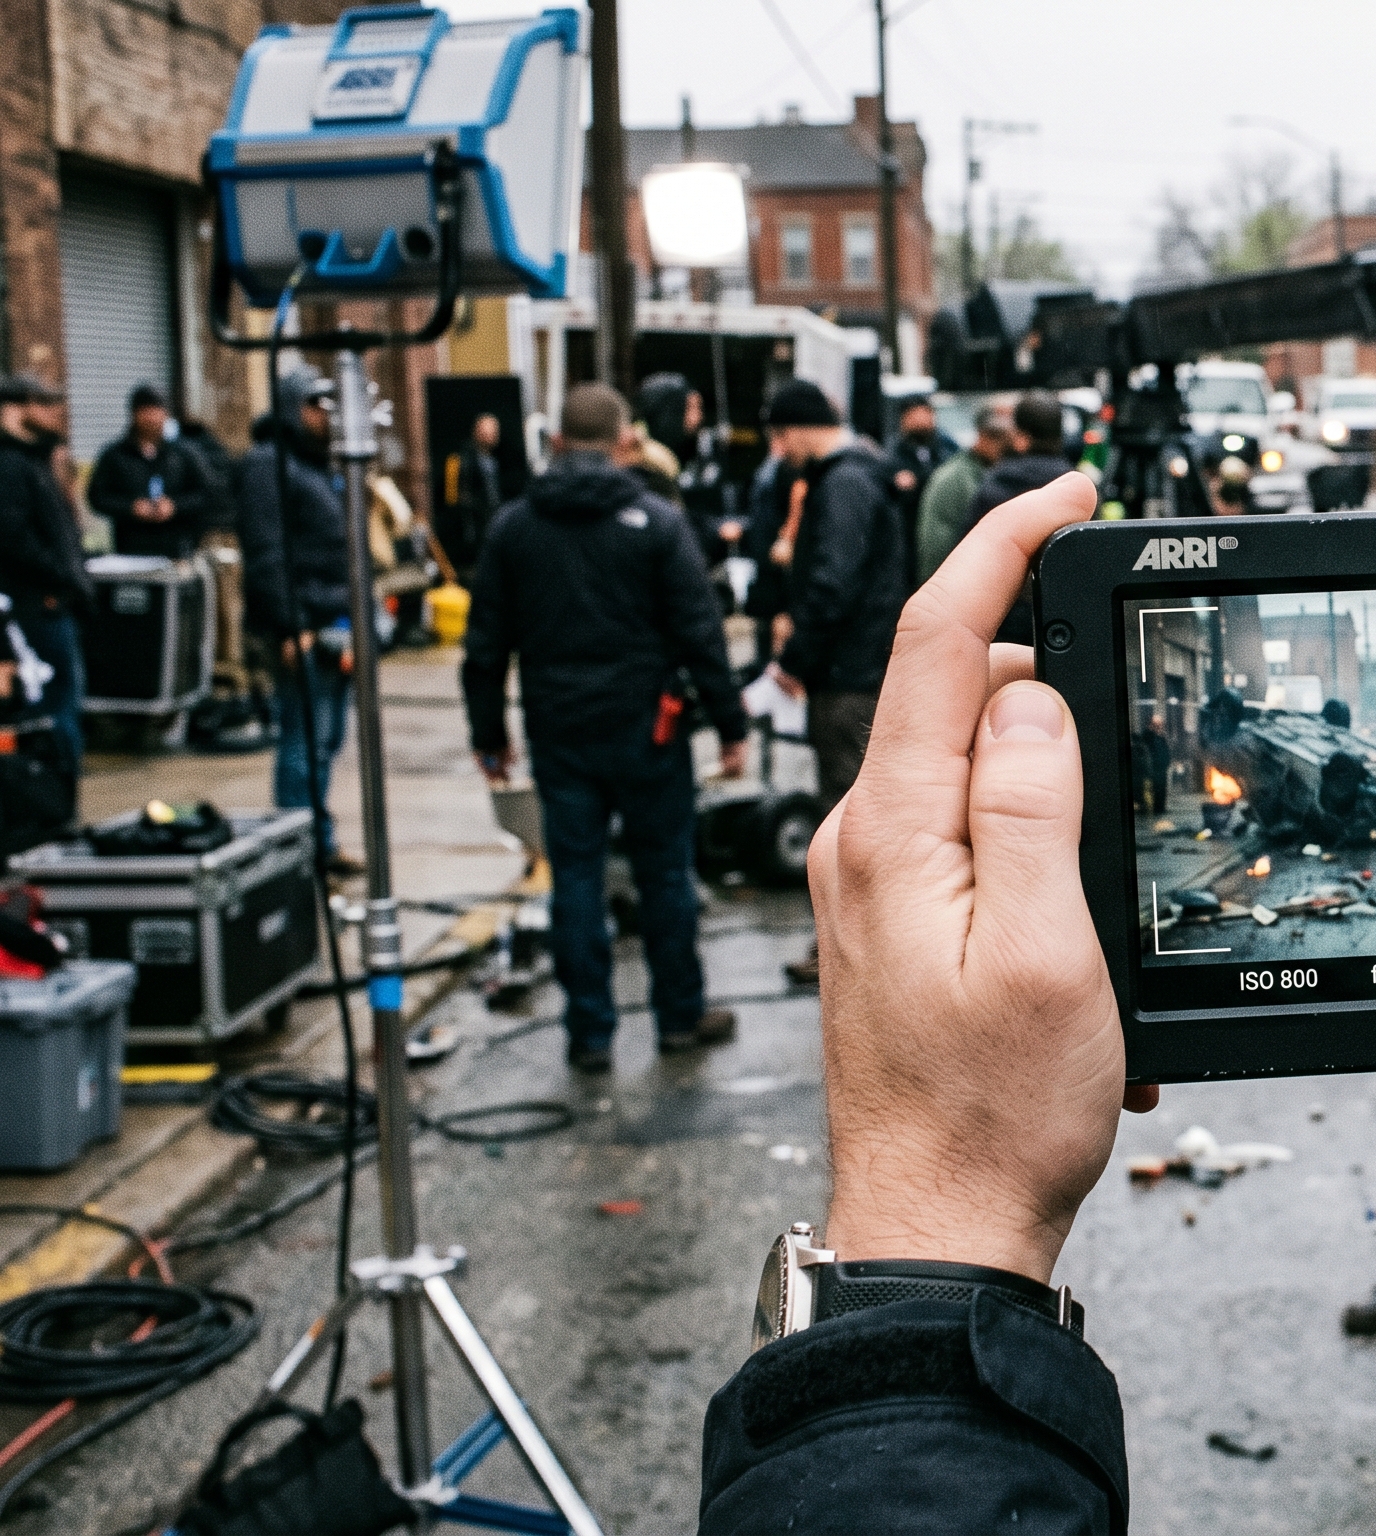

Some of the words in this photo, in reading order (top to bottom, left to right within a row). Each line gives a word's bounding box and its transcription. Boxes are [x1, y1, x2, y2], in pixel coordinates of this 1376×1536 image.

[1132, 537, 1217, 570] ARRI
[1240, 971, 1273, 990] ISO
[1281, 969, 1317, 988] 800
